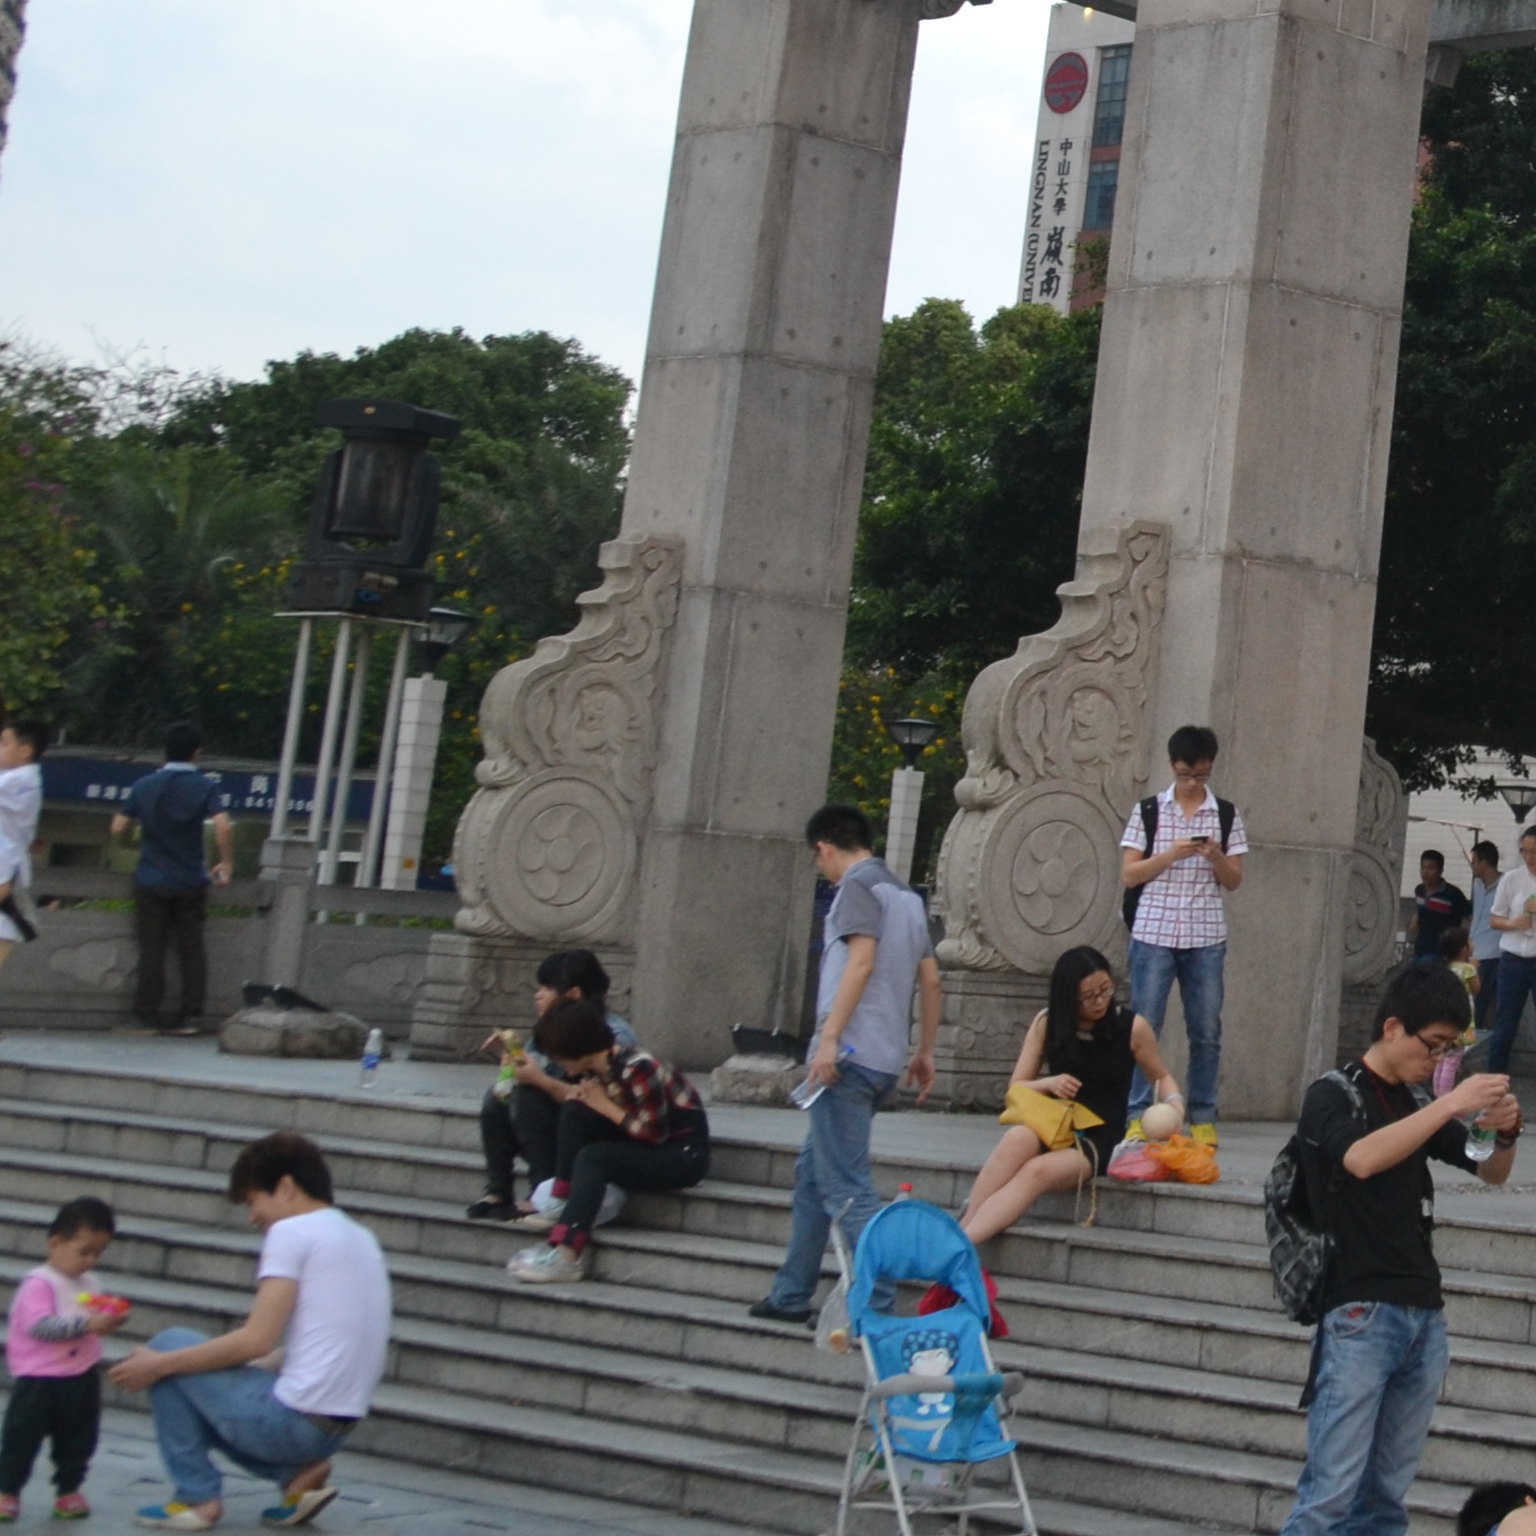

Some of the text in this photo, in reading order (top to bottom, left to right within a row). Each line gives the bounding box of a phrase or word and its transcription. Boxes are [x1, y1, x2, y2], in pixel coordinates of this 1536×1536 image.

[1022, 139, 1050, 303] LINGNAN (UNIVE
[1039, 138, 1072, 304] 中山大學 嶺南
